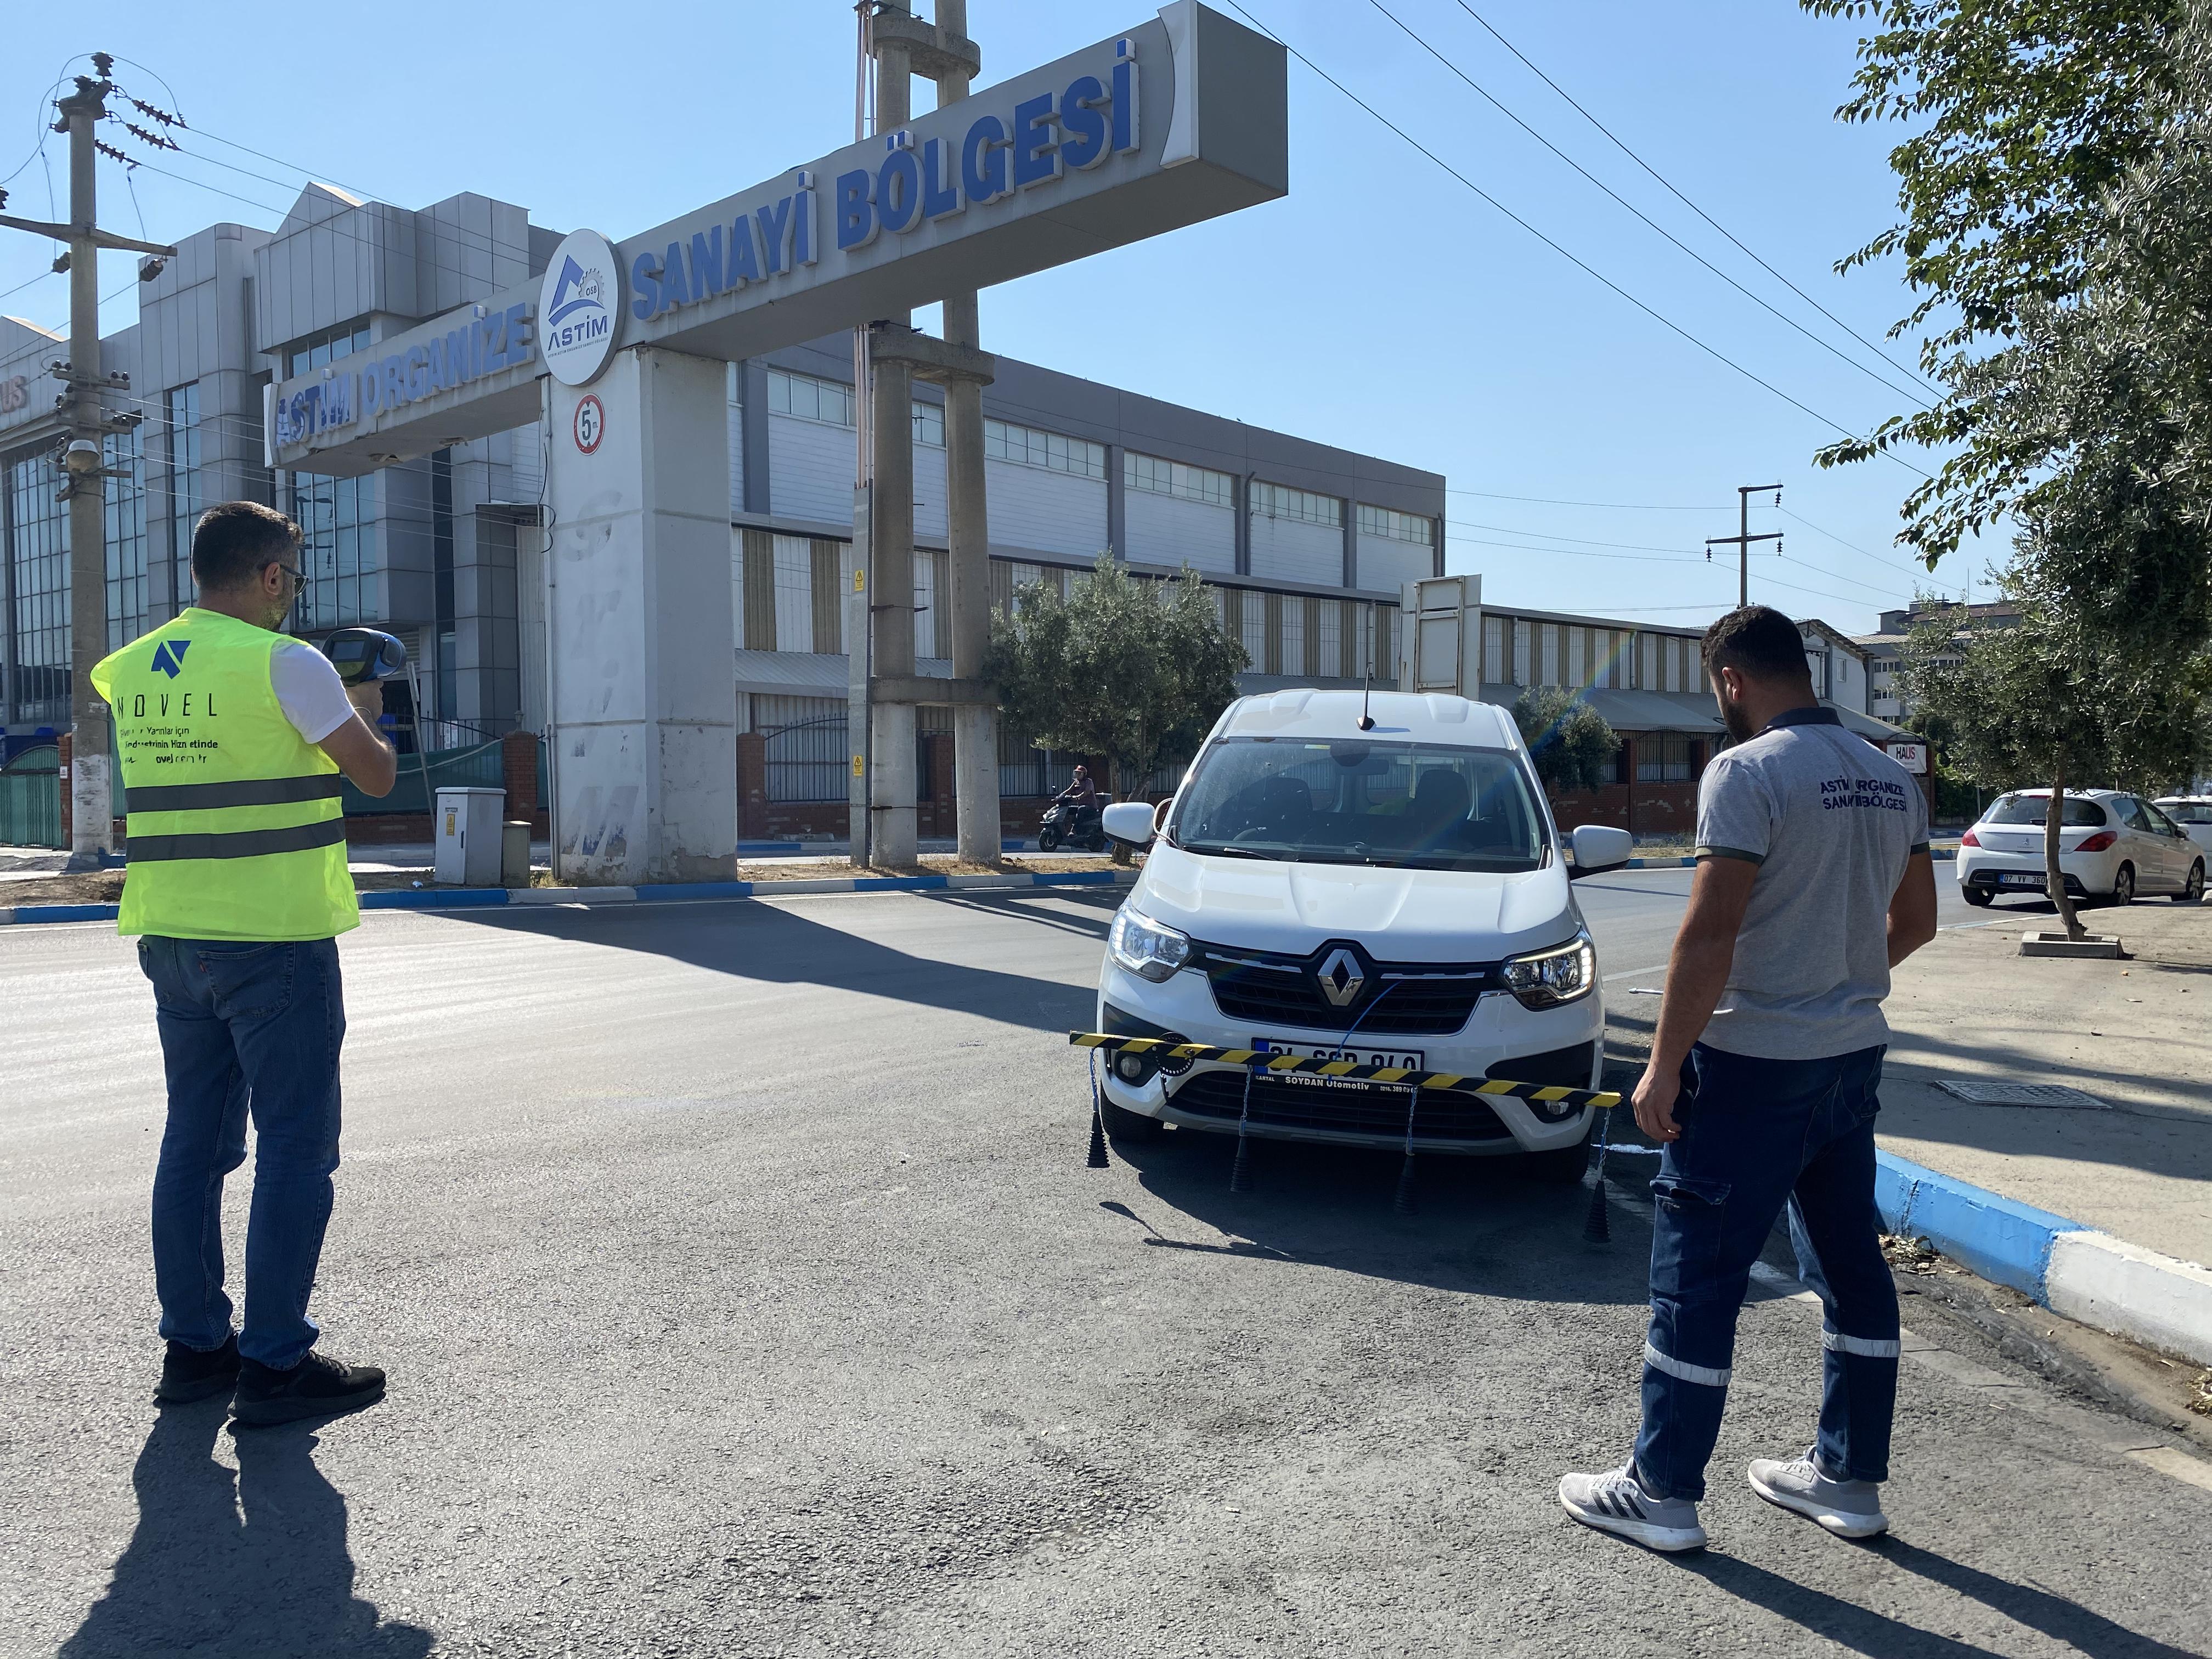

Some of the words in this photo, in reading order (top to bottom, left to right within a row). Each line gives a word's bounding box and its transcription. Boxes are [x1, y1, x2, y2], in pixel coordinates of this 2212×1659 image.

[362, 302, 534, 416] ORGANİZE
[632, 171, 817, 323] SANAYİ
[837, 38, 1139, 251] BÖLGESİ
[586, 285, 597, 296] OSB
[548, 315, 608, 351] ASTİM
[582, 409, 591, 441] 5
[117, 693, 218, 720] NOVEL
[1896, 747, 1915, 759] HAUS
[1285, 1076, 1323, 1087] SOYDAN
[1327, 1080, 1369, 1090] Otomotiv
